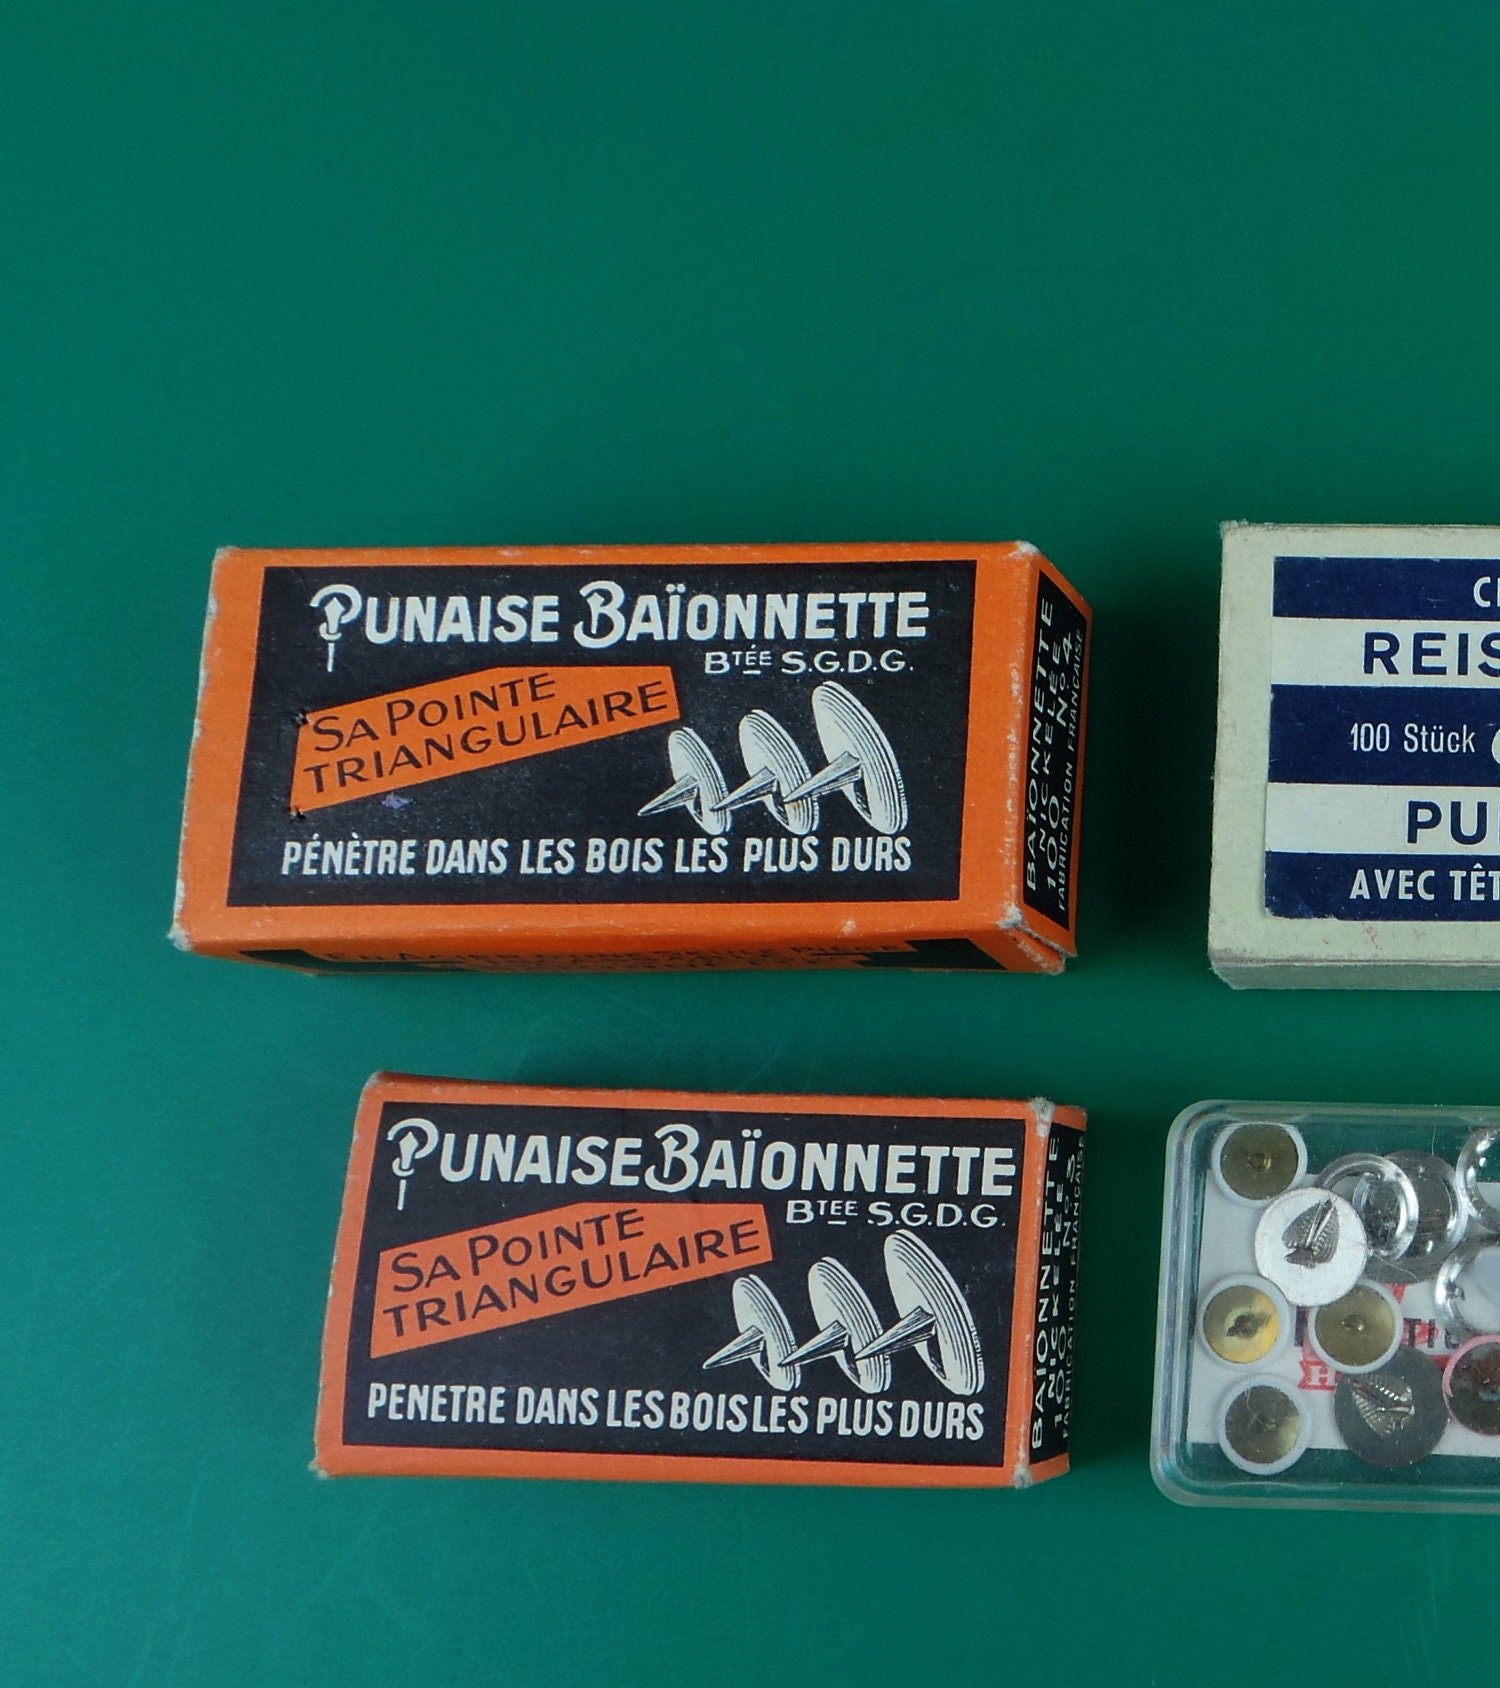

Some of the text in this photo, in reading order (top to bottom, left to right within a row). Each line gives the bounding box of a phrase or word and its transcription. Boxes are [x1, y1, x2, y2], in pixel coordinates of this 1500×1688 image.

[309, 580, 930, 672] PUNAISE BAÏONNETTE
[781, 649, 915, 675] S.G.D.G.
[303, 681, 670, 794] TRIANGULAIRE
[312, 672, 556, 752] SA POINTE
[1026, 597, 1053, 892] BAÏONNETTE
[1039, 641, 1061, 853] NICKELÉE
[1349, 722, 1476, 755] 100 Stück
[281, 833, 912, 877] PÉNÈTRE DANS LES BOIS LES PLUS DURS
[1046, 794, 1060, 890] 100
[1058, 761, 1073, 911] FABRICATION
[1349, 868, 1436, 901] AVEC
[386, 1117, 1017, 1211] PUNAISE BAÏONNETTE
[390, 1208, 645, 1294] SA POINTE
[868, 1201, 1006, 1229] S.G.D.G.
[382, 1219, 761, 1338] TRIANGULAIRE
[1054, 1325, 1067, 1429] 100
[1062, 1278, 1076, 1439] FABRICATION
[367, 1383, 985, 1441] PENETRE DANS LES BOIS LES PLUS DURS
